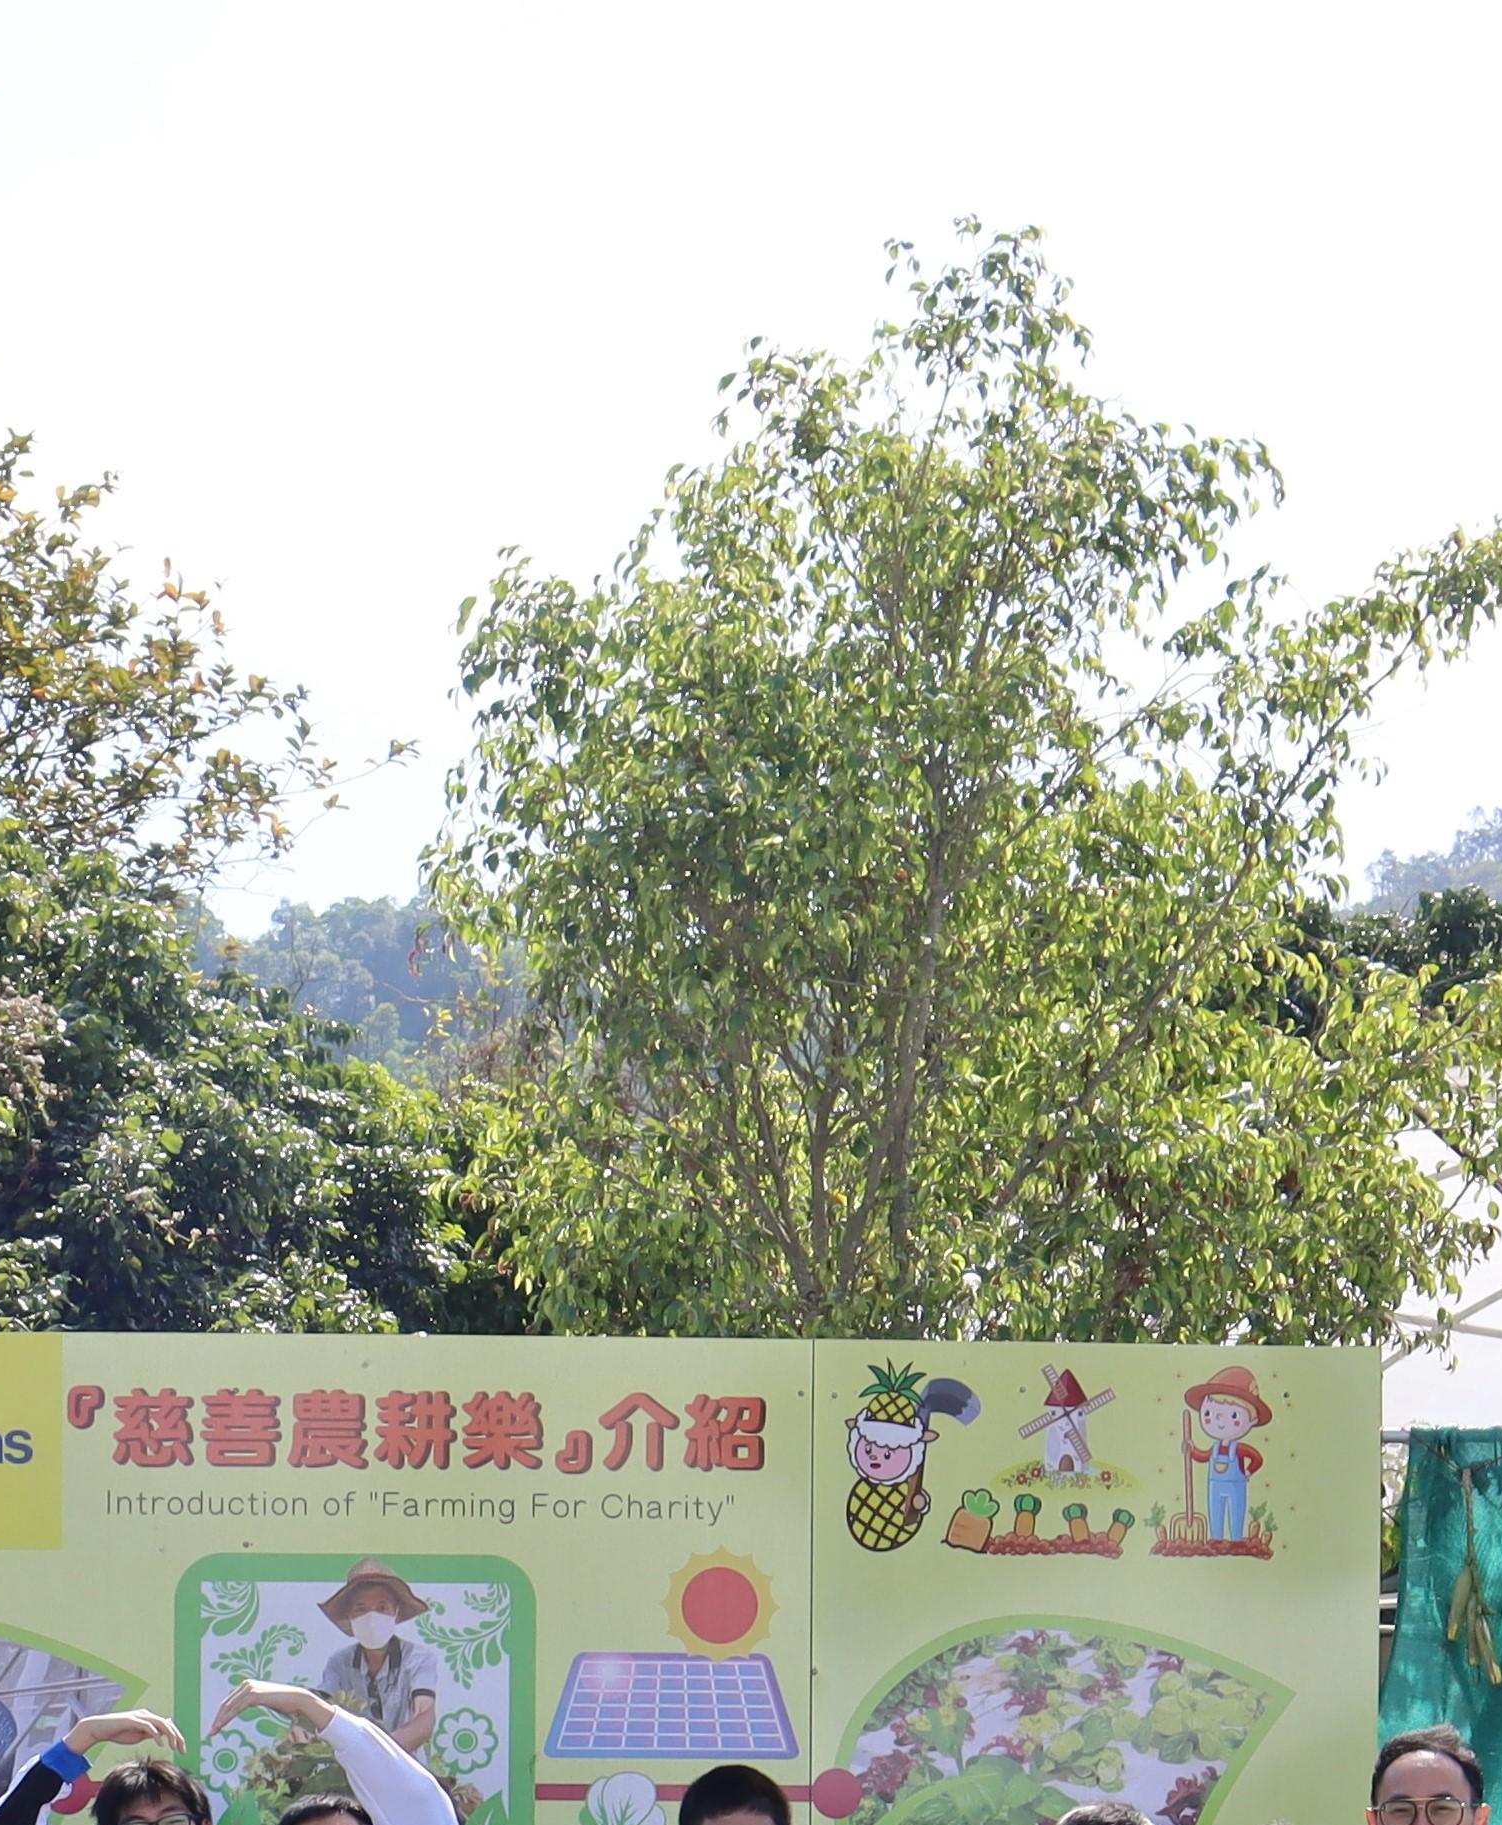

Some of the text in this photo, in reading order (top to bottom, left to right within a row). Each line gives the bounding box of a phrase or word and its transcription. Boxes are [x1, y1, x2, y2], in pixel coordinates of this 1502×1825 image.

[107, 1490, 734, 1527] Introduction of "Farming For Charity"
